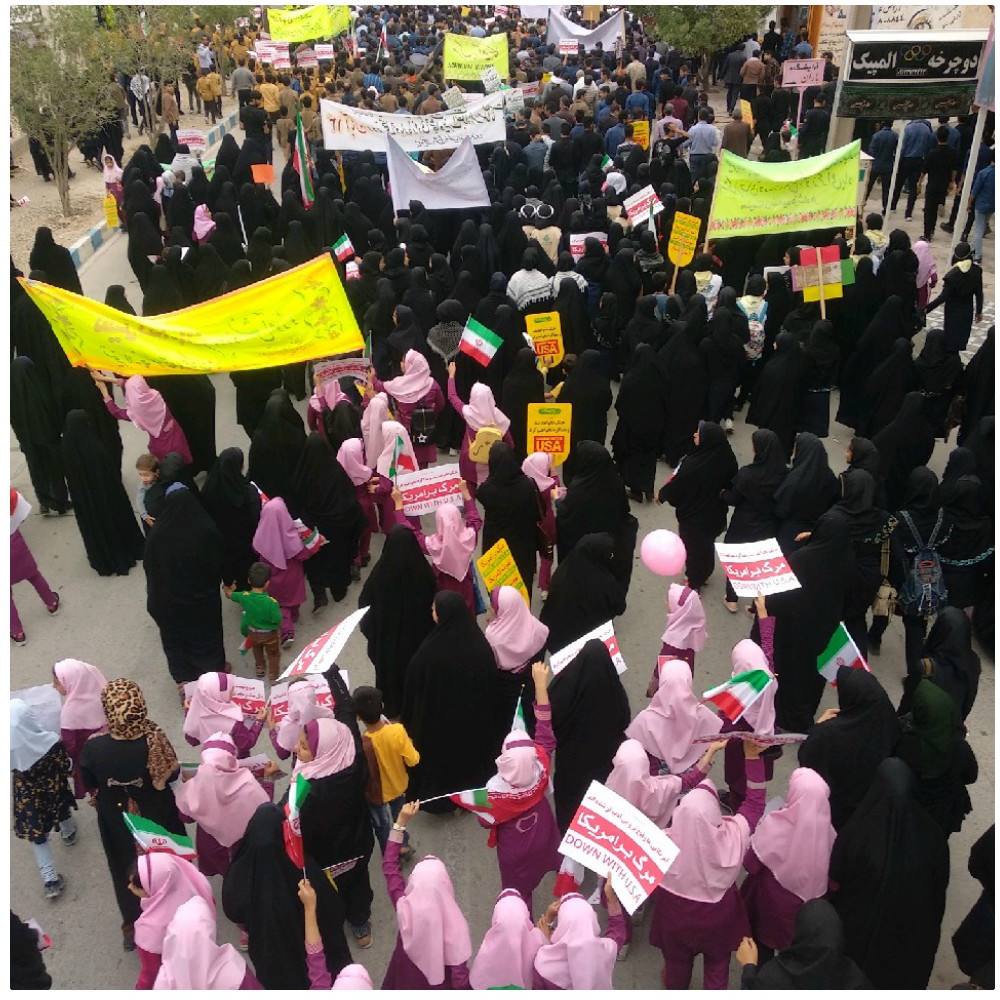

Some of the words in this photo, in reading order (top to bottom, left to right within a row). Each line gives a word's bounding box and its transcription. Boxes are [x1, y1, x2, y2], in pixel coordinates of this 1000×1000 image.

[852, 50, 898, 76] المپیک
[927, 50, 979, 75] دوچرخه
[535, 341, 560, 355] USA
[535, 440, 562, 452] USA
[402, 489, 426, 502] امریک
[438, 482, 460, 494] مرگ
[404, 503, 423, 513] OWN
[761, 561, 787, 574] مرگ
[577, 811, 621, 846] امریکا
[564, 834, 603, 861] DOWN
[602, 853, 627, 880] WITH
[611, 843, 634, 860] بر
[631, 856, 657, 884] مرگ
